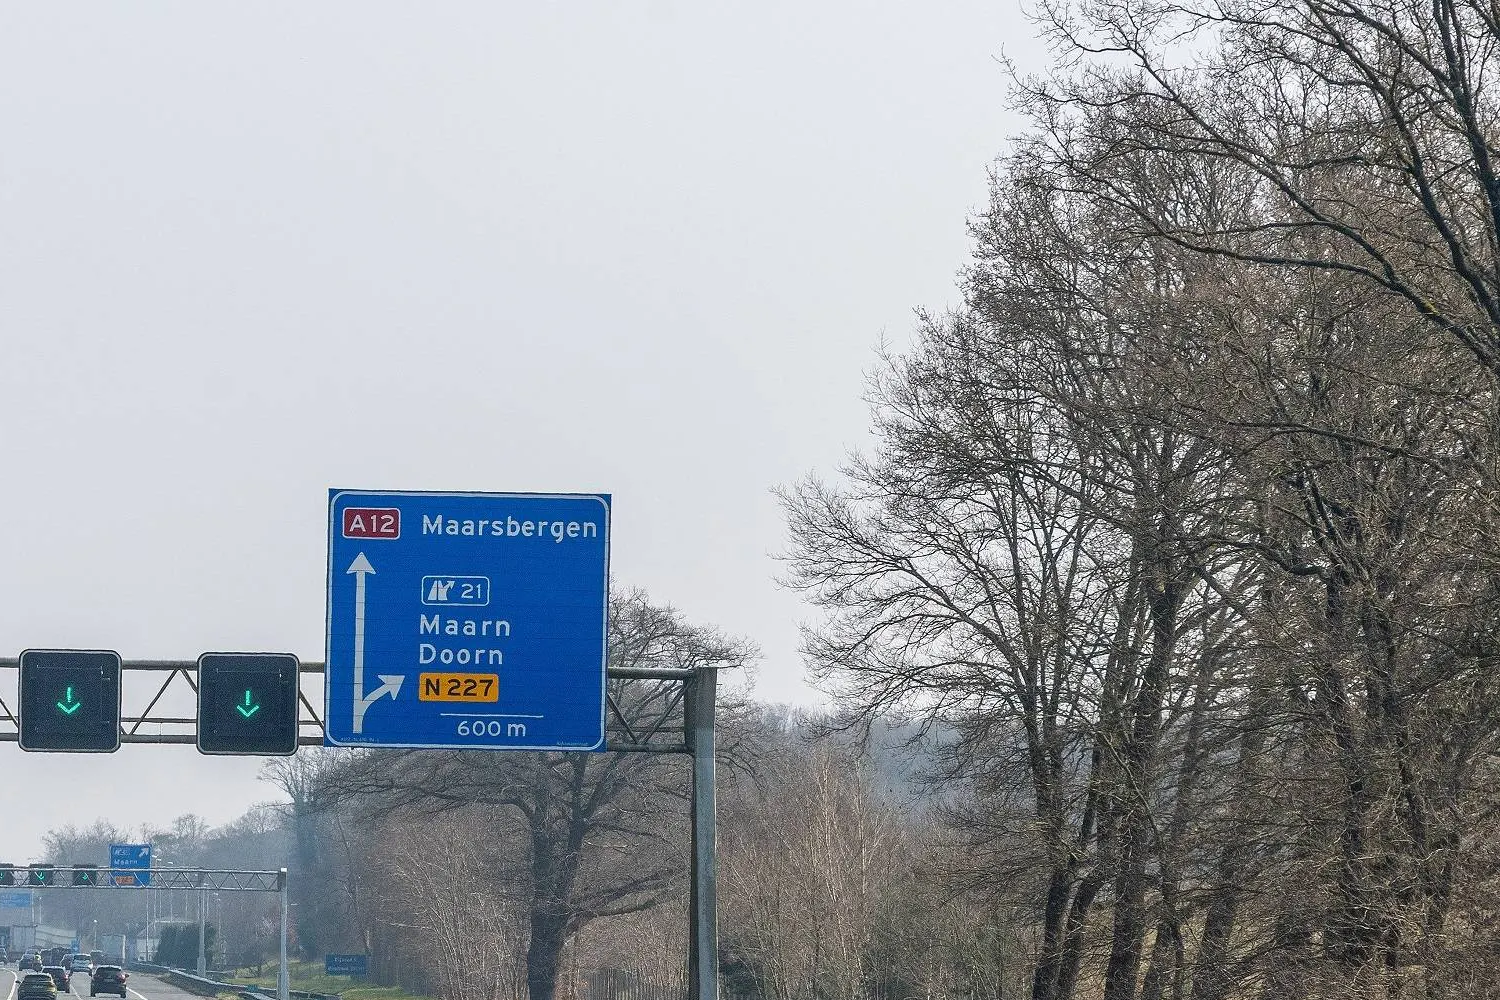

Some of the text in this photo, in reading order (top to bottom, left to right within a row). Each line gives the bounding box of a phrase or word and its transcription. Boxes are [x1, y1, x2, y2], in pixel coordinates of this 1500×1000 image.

[349, 514, 395, 533] A12
[422, 514, 597, 544] Maarsbergen
[461, 583, 481, 599] 21
[419, 613, 511, 637] Maarn
[419, 643, 503, 665] Doorn
[425, 678, 494, 697] N 227
[457, 720, 527, 737] 600 m
